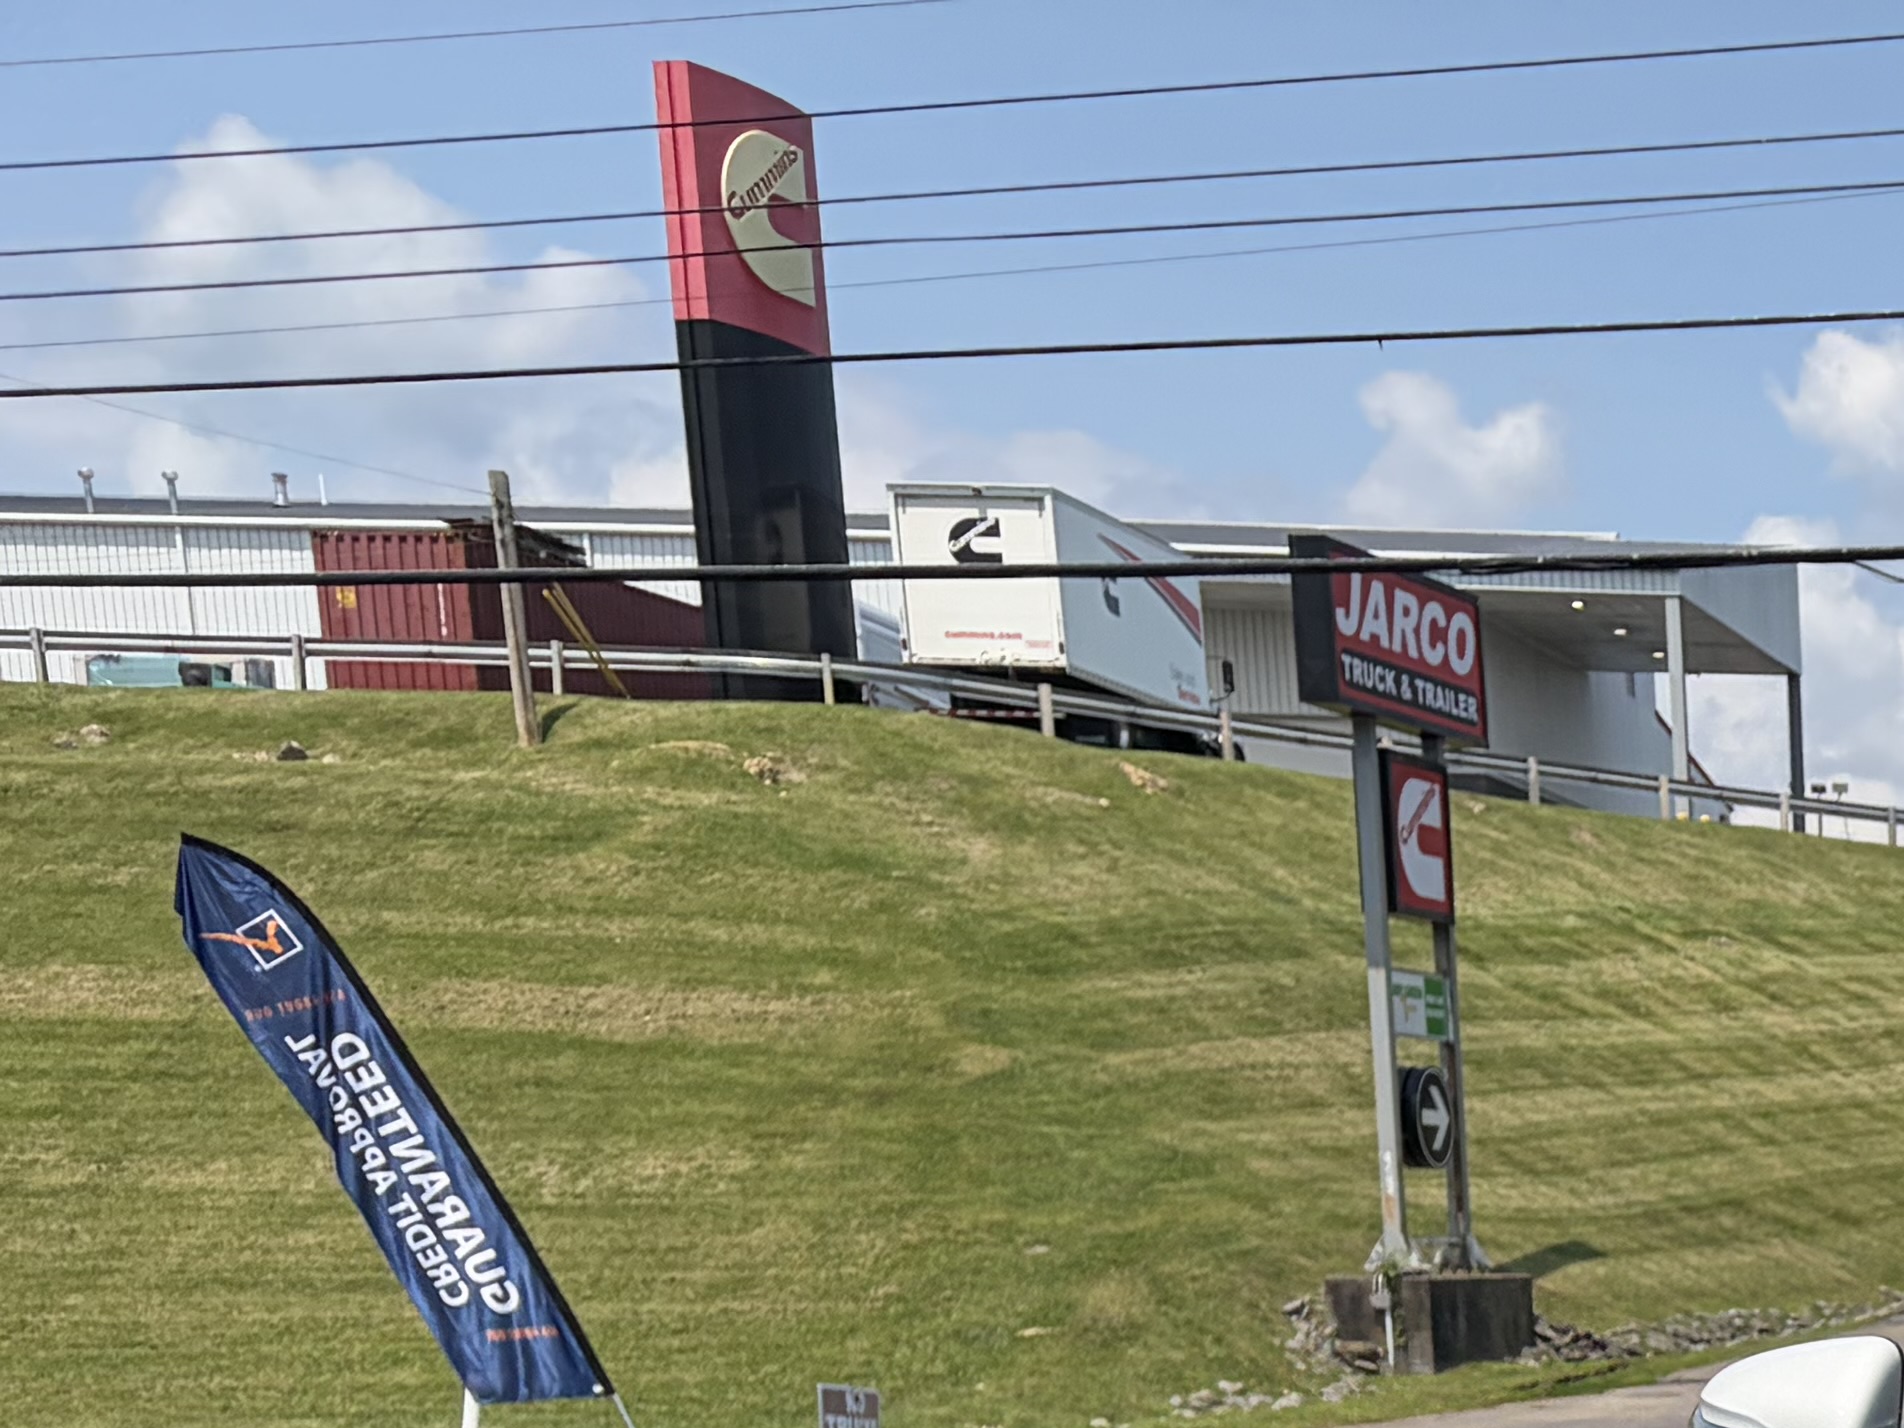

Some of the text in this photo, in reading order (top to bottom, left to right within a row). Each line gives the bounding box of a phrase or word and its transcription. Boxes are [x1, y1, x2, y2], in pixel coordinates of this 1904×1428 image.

[1335, 572, 1476, 676] JARCO
[1341, 653, 1479, 722] TRUCK & TRAILER
